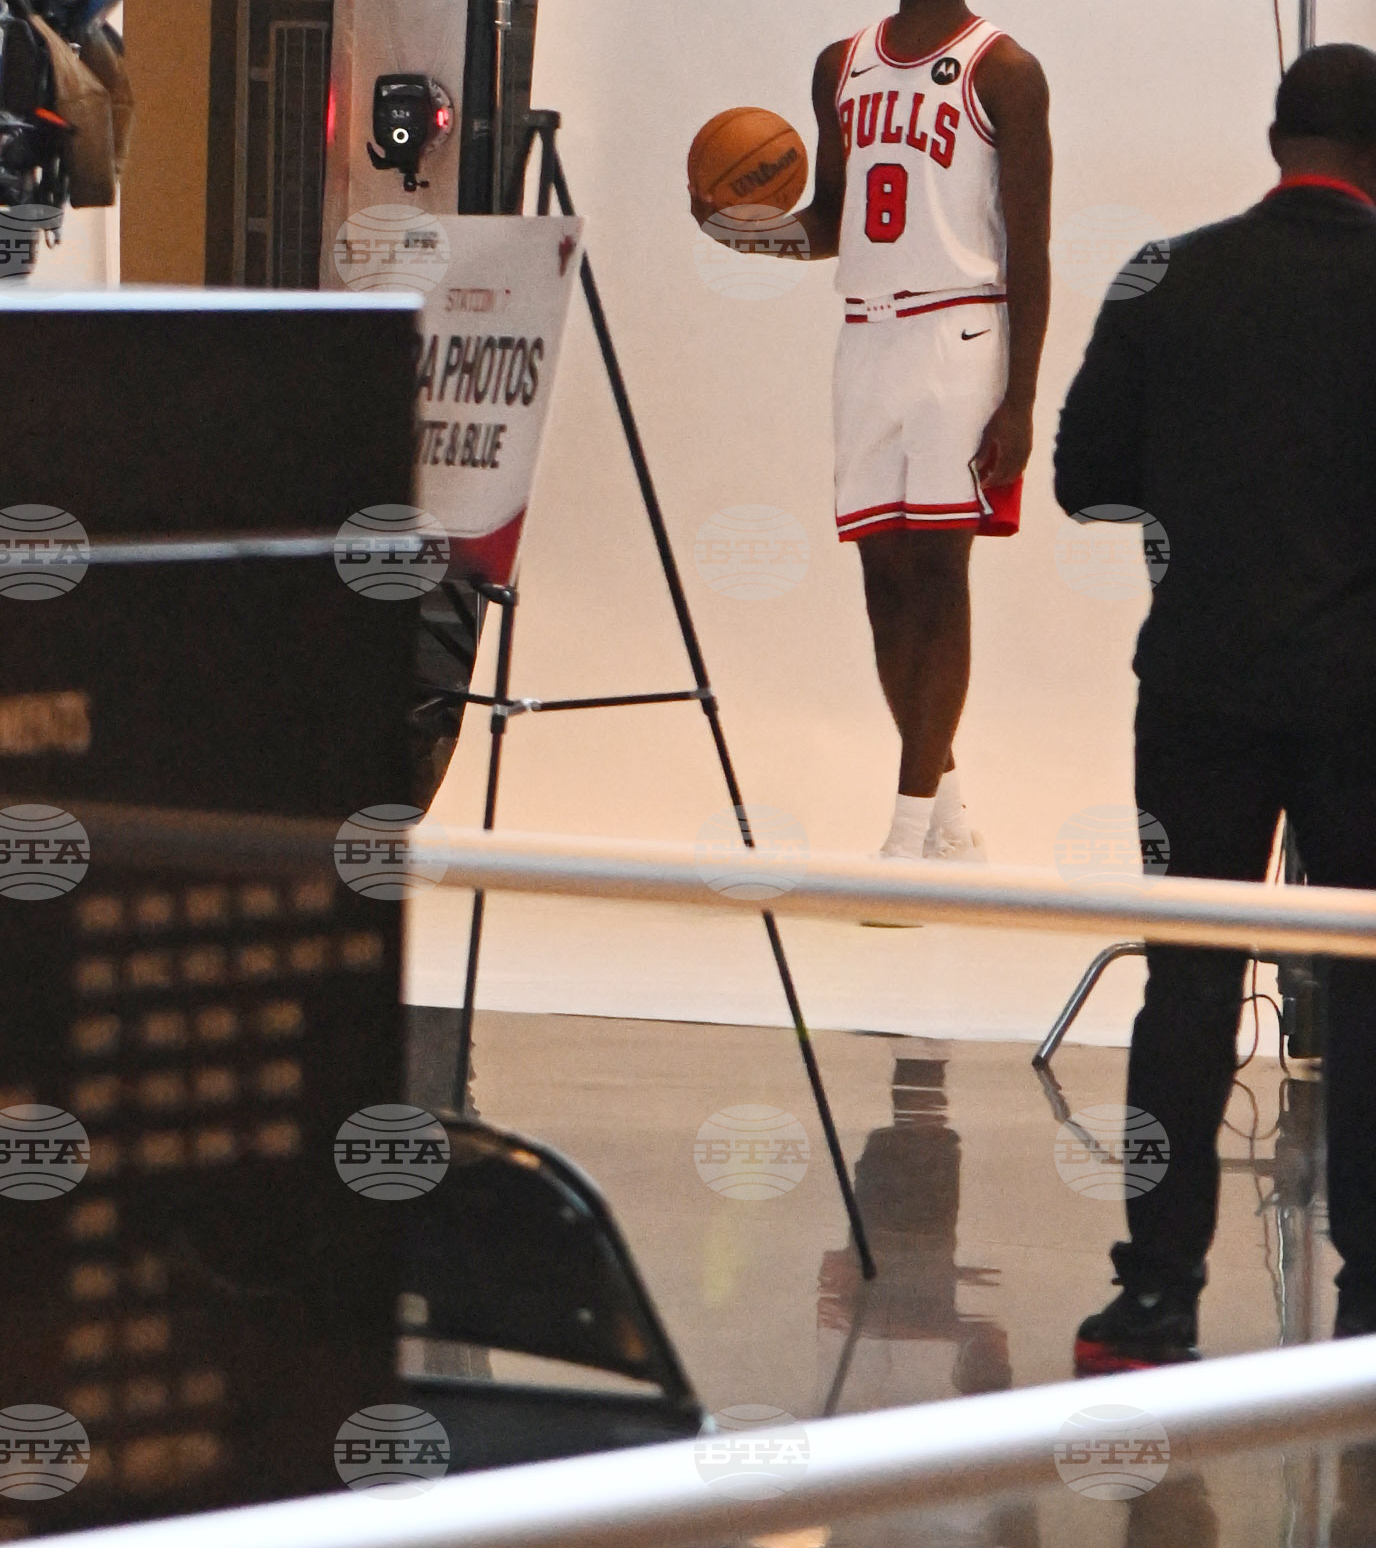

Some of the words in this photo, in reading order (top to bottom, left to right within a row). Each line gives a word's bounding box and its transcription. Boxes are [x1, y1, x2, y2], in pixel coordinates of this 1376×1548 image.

[839, 90, 961, 169] BULLS
[865, 163, 907, 243] 8
[438, 336, 544, 406] PHOTOS
[460, 423, 507, 469] BLUE
